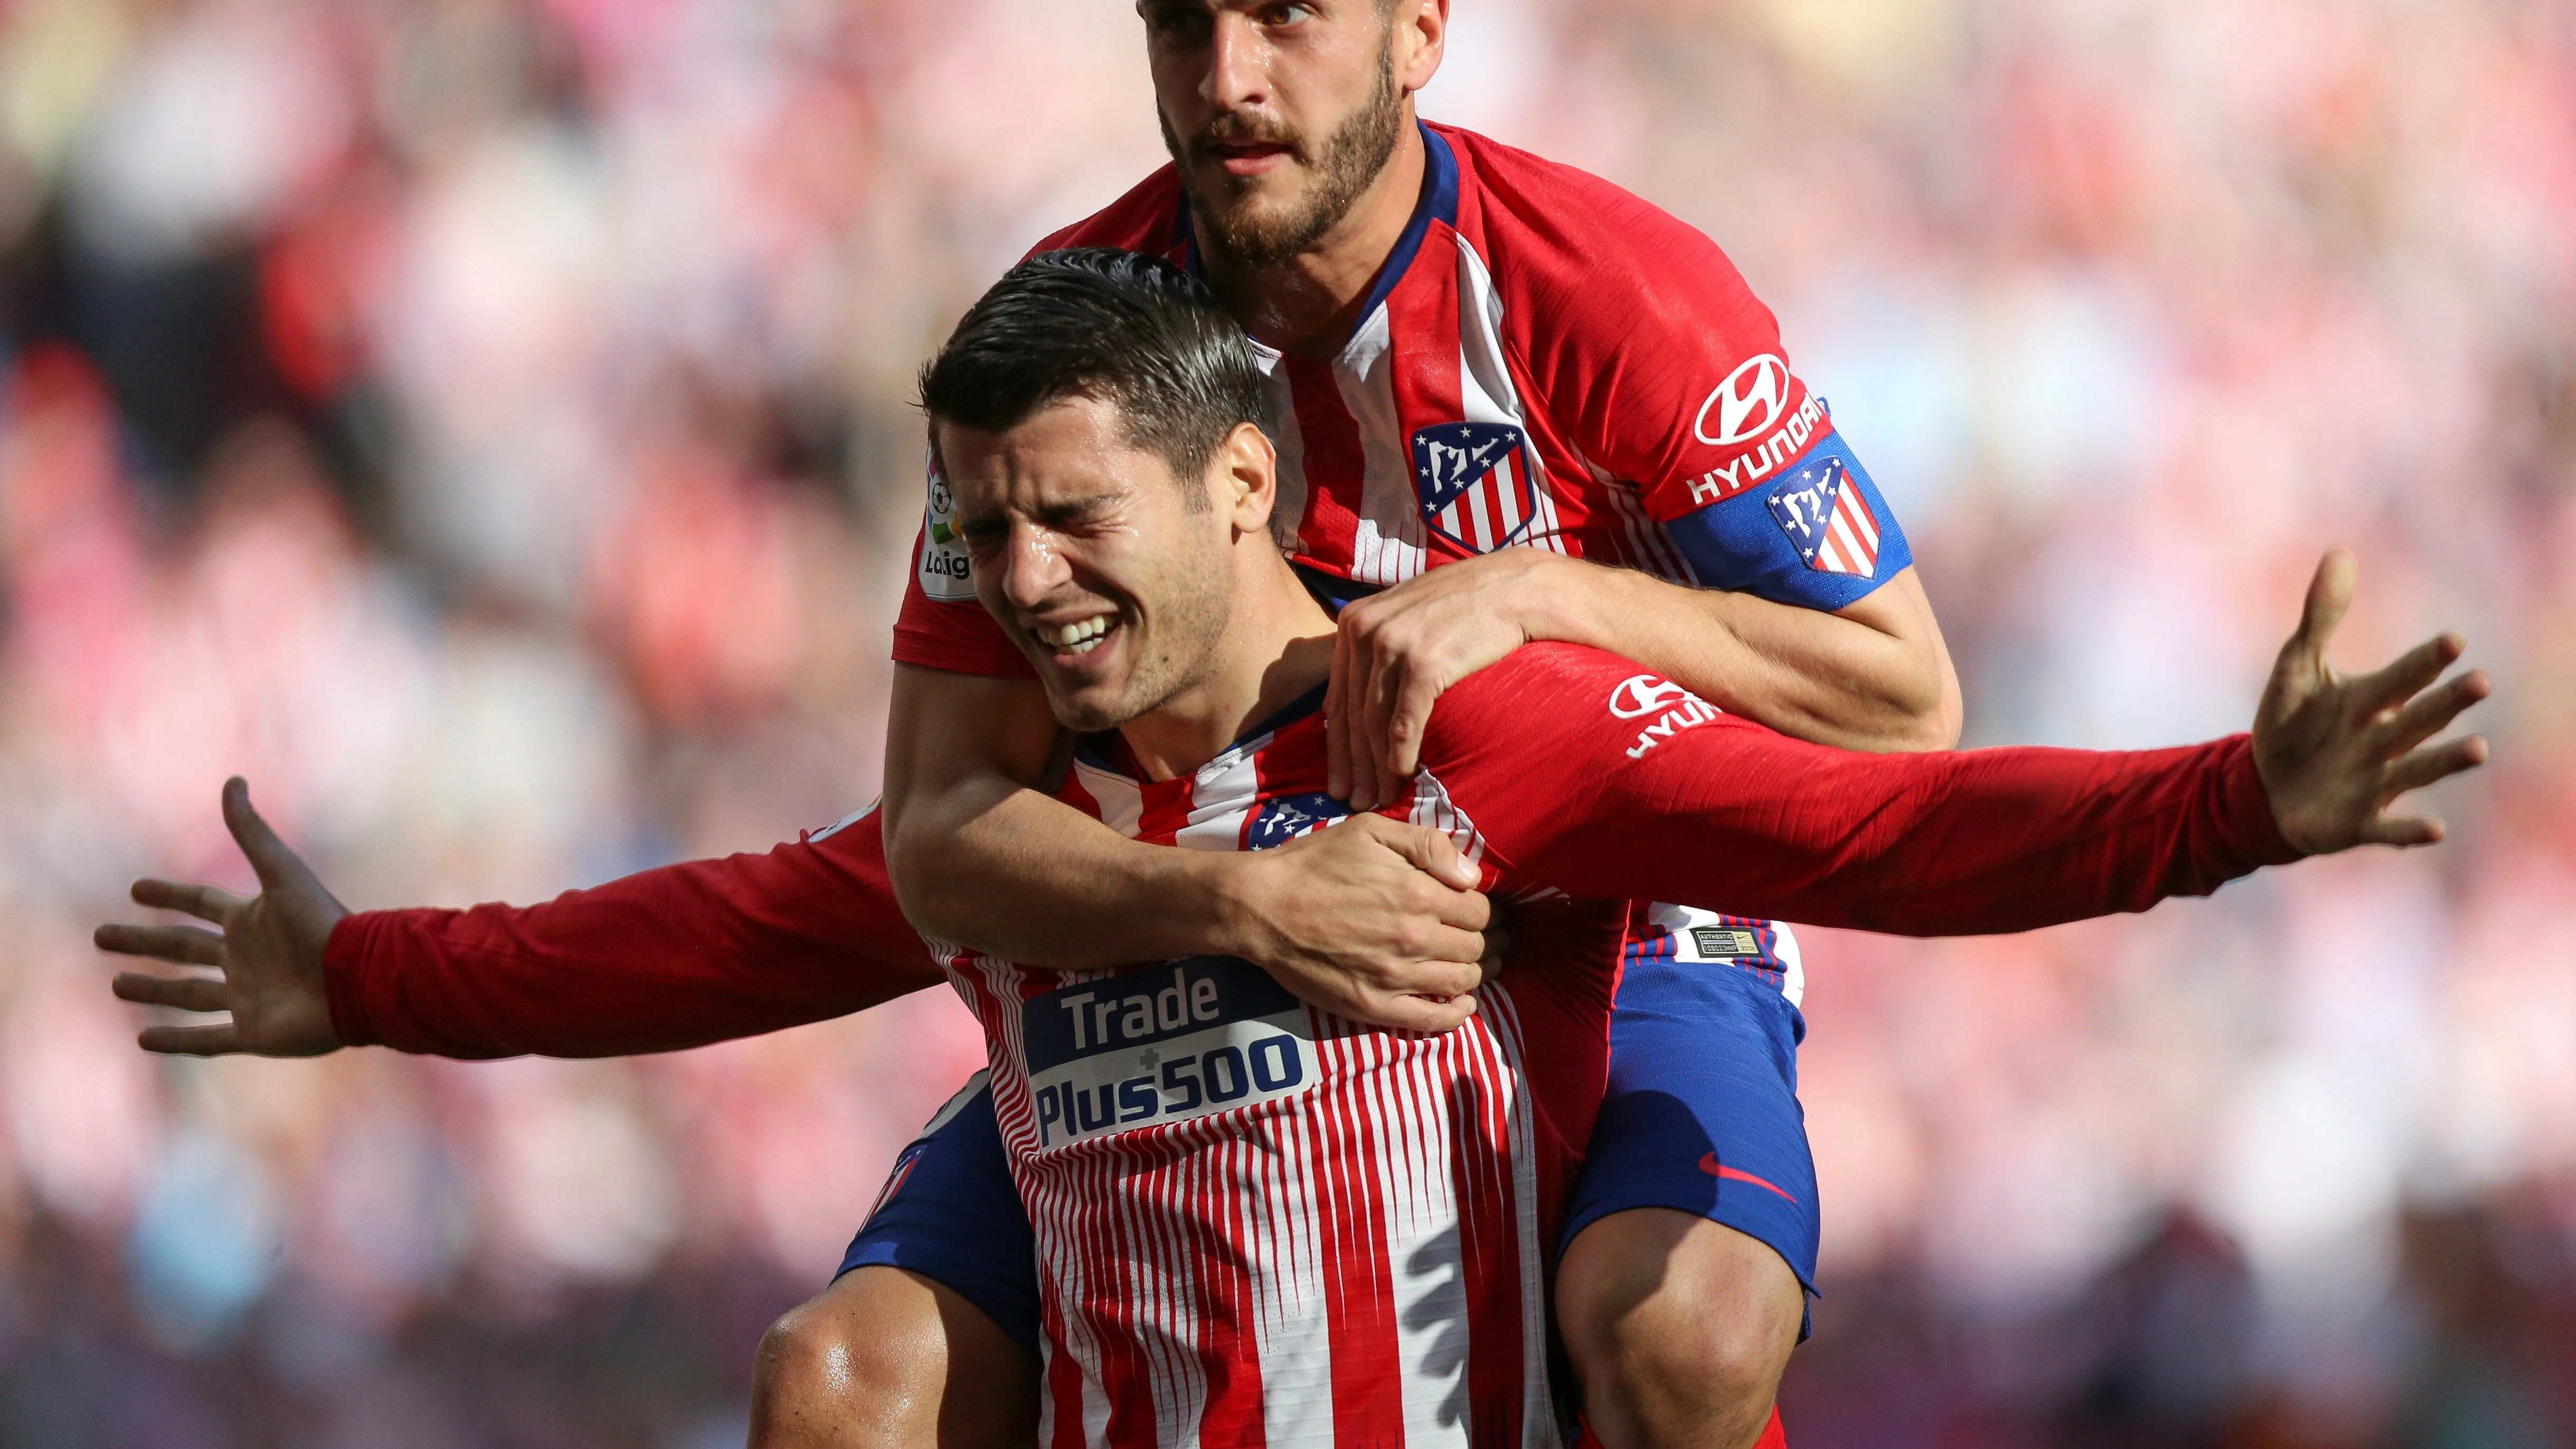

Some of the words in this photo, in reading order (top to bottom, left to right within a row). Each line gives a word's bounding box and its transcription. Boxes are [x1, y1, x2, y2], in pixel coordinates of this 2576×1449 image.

[1686, 390, 1823, 505] HYUNDAI
[1061, 968, 1220, 1049] Trade
[1035, 1034, 1303, 1148] Plus500
